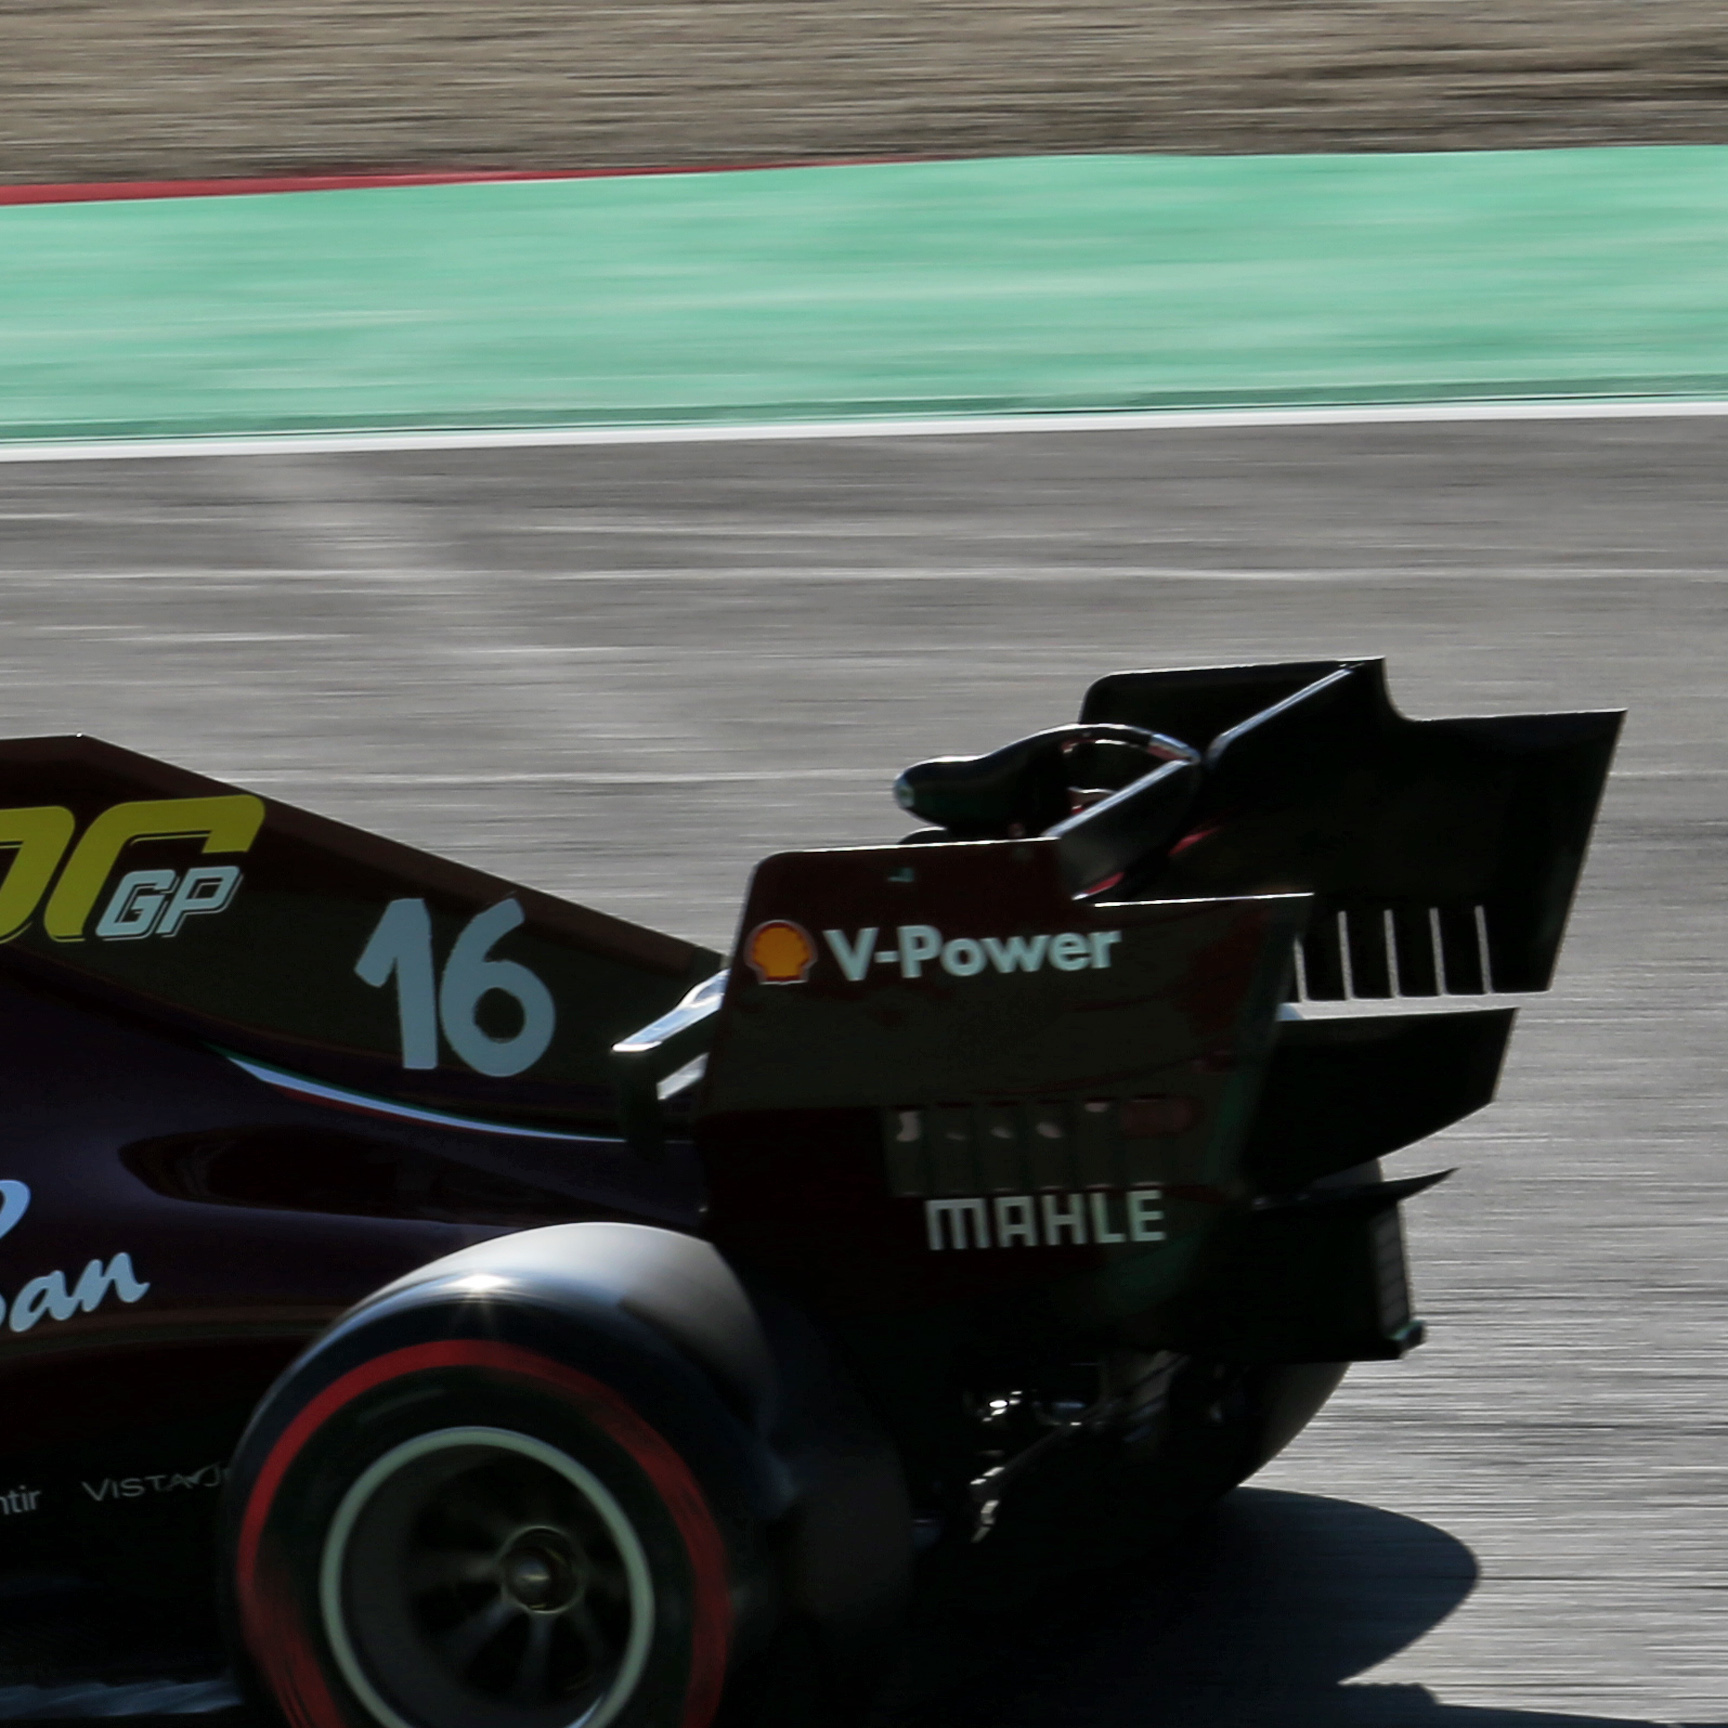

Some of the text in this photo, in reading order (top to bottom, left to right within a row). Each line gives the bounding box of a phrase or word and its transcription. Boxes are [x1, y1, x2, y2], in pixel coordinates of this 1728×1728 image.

[95, 865, 242, 941] GP
[353, 897, 556, 1077] 16
[825, 923, 1122, 982] V-Power
[924, 1190, 1167, 1252] MAHLE
